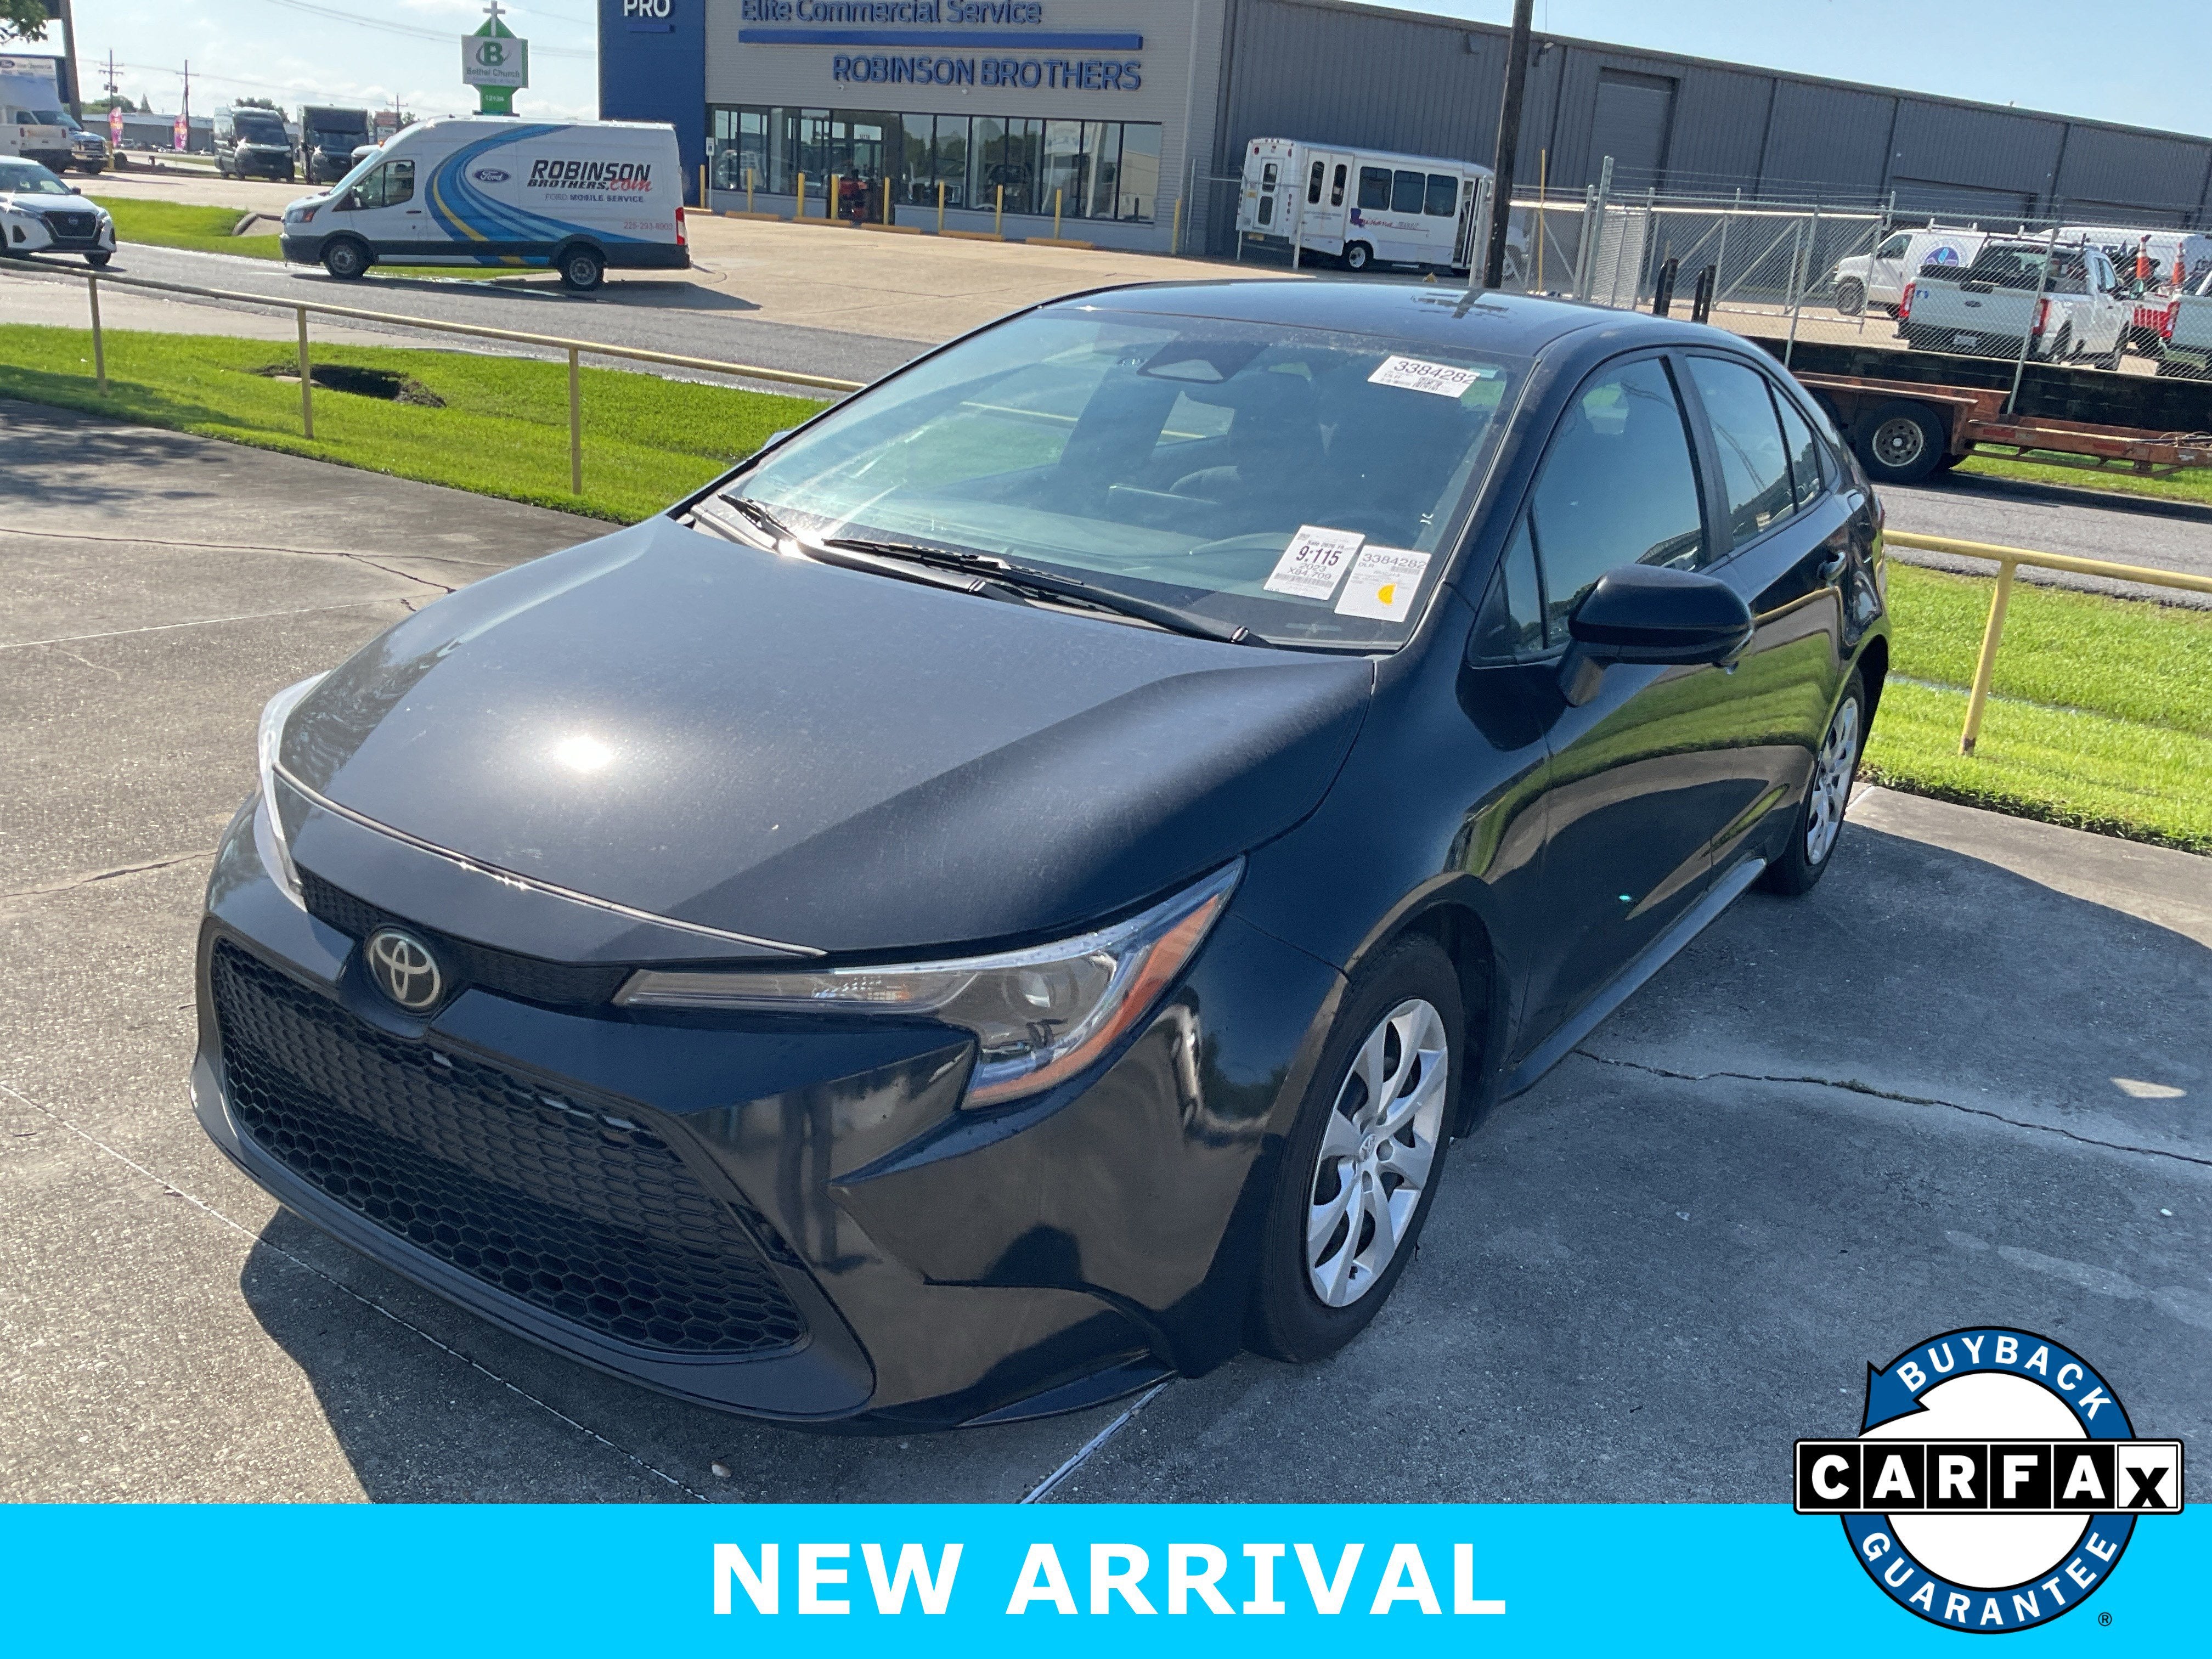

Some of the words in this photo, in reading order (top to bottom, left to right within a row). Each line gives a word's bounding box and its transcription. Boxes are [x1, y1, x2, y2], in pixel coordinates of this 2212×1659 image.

[623, 0, 670, 18] PRO
[742, 0, 791, 21] Elite
[797, 0, 940, 23] Commercial
[947, 0, 1042, 24] Service
[493, 69, 520, 77] Church
[833, 55, 975, 86] ROBINSON
[980, 57, 1142, 91] BROTHERS
[531, 160, 652, 181] ROBINSON
[607, 195, 644, 203] SERVICE
[1393, 360, 1477, 385] 3384282
[1295, 546, 1342, 566] 9:115
[1363, 554, 1427, 569] 3384282
[1299, 562, 1327, 572] 2023
